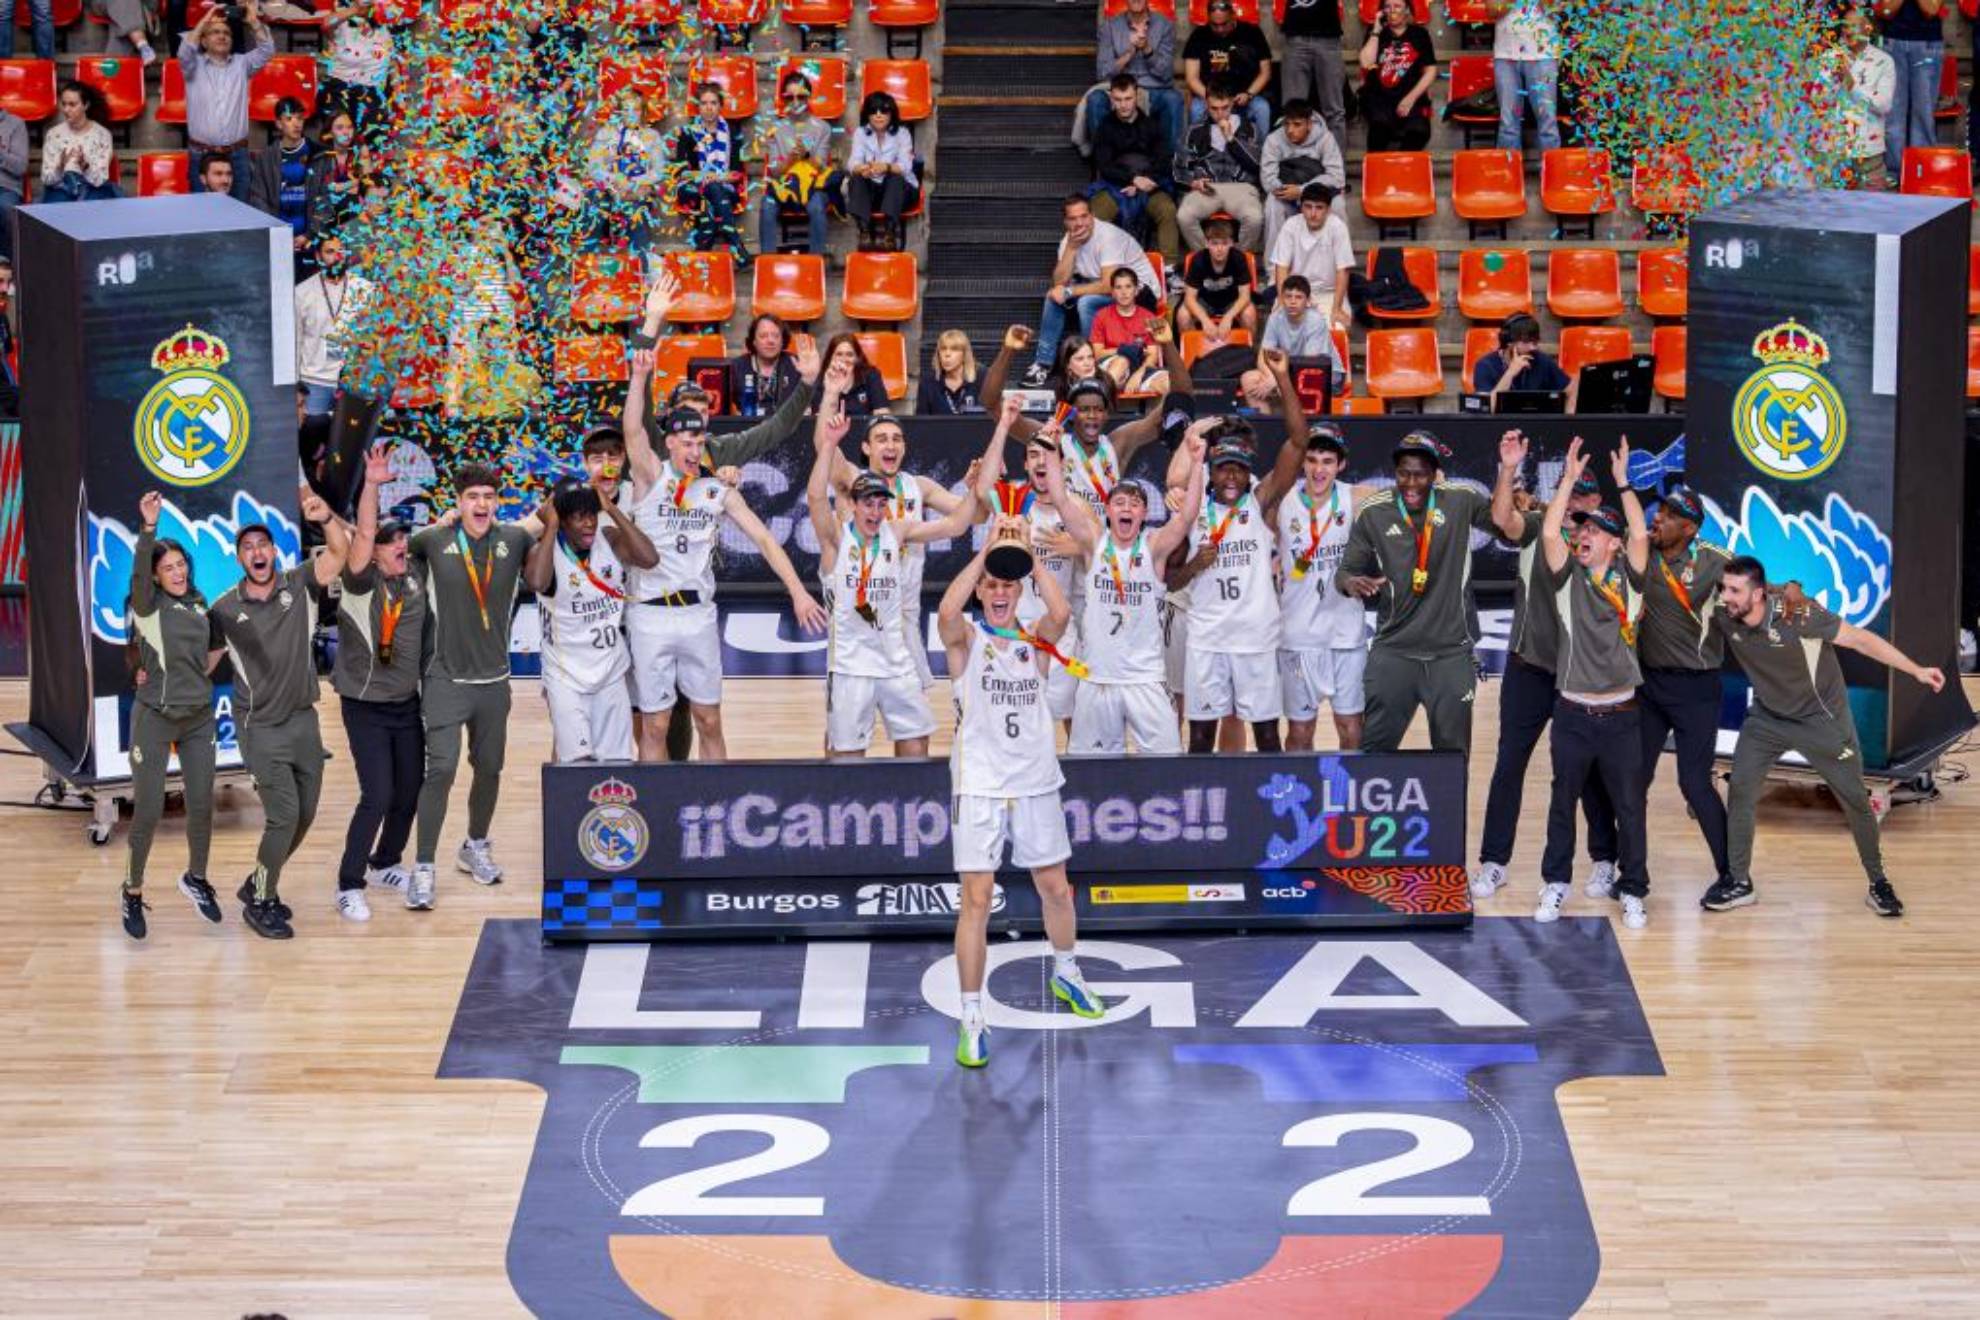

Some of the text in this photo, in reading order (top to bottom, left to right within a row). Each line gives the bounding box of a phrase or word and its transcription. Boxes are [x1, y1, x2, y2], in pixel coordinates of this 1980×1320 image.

[1298, 368, 1323, 415] 5
[676, 534, 689, 555] 8
[1216, 576, 1241, 601] 16
[1110, 611, 1123, 636] 7
[590, 624, 618, 650] 20
[1005, 712, 1020, 738] 6
[1322, 777, 1430, 813] LIGA
[1323, 814, 1431, 859] U22
[706, 893, 841, 913] Burgos
[1262, 886, 1307, 898] acb
[568, 941, 1530, 1029] LIGA
